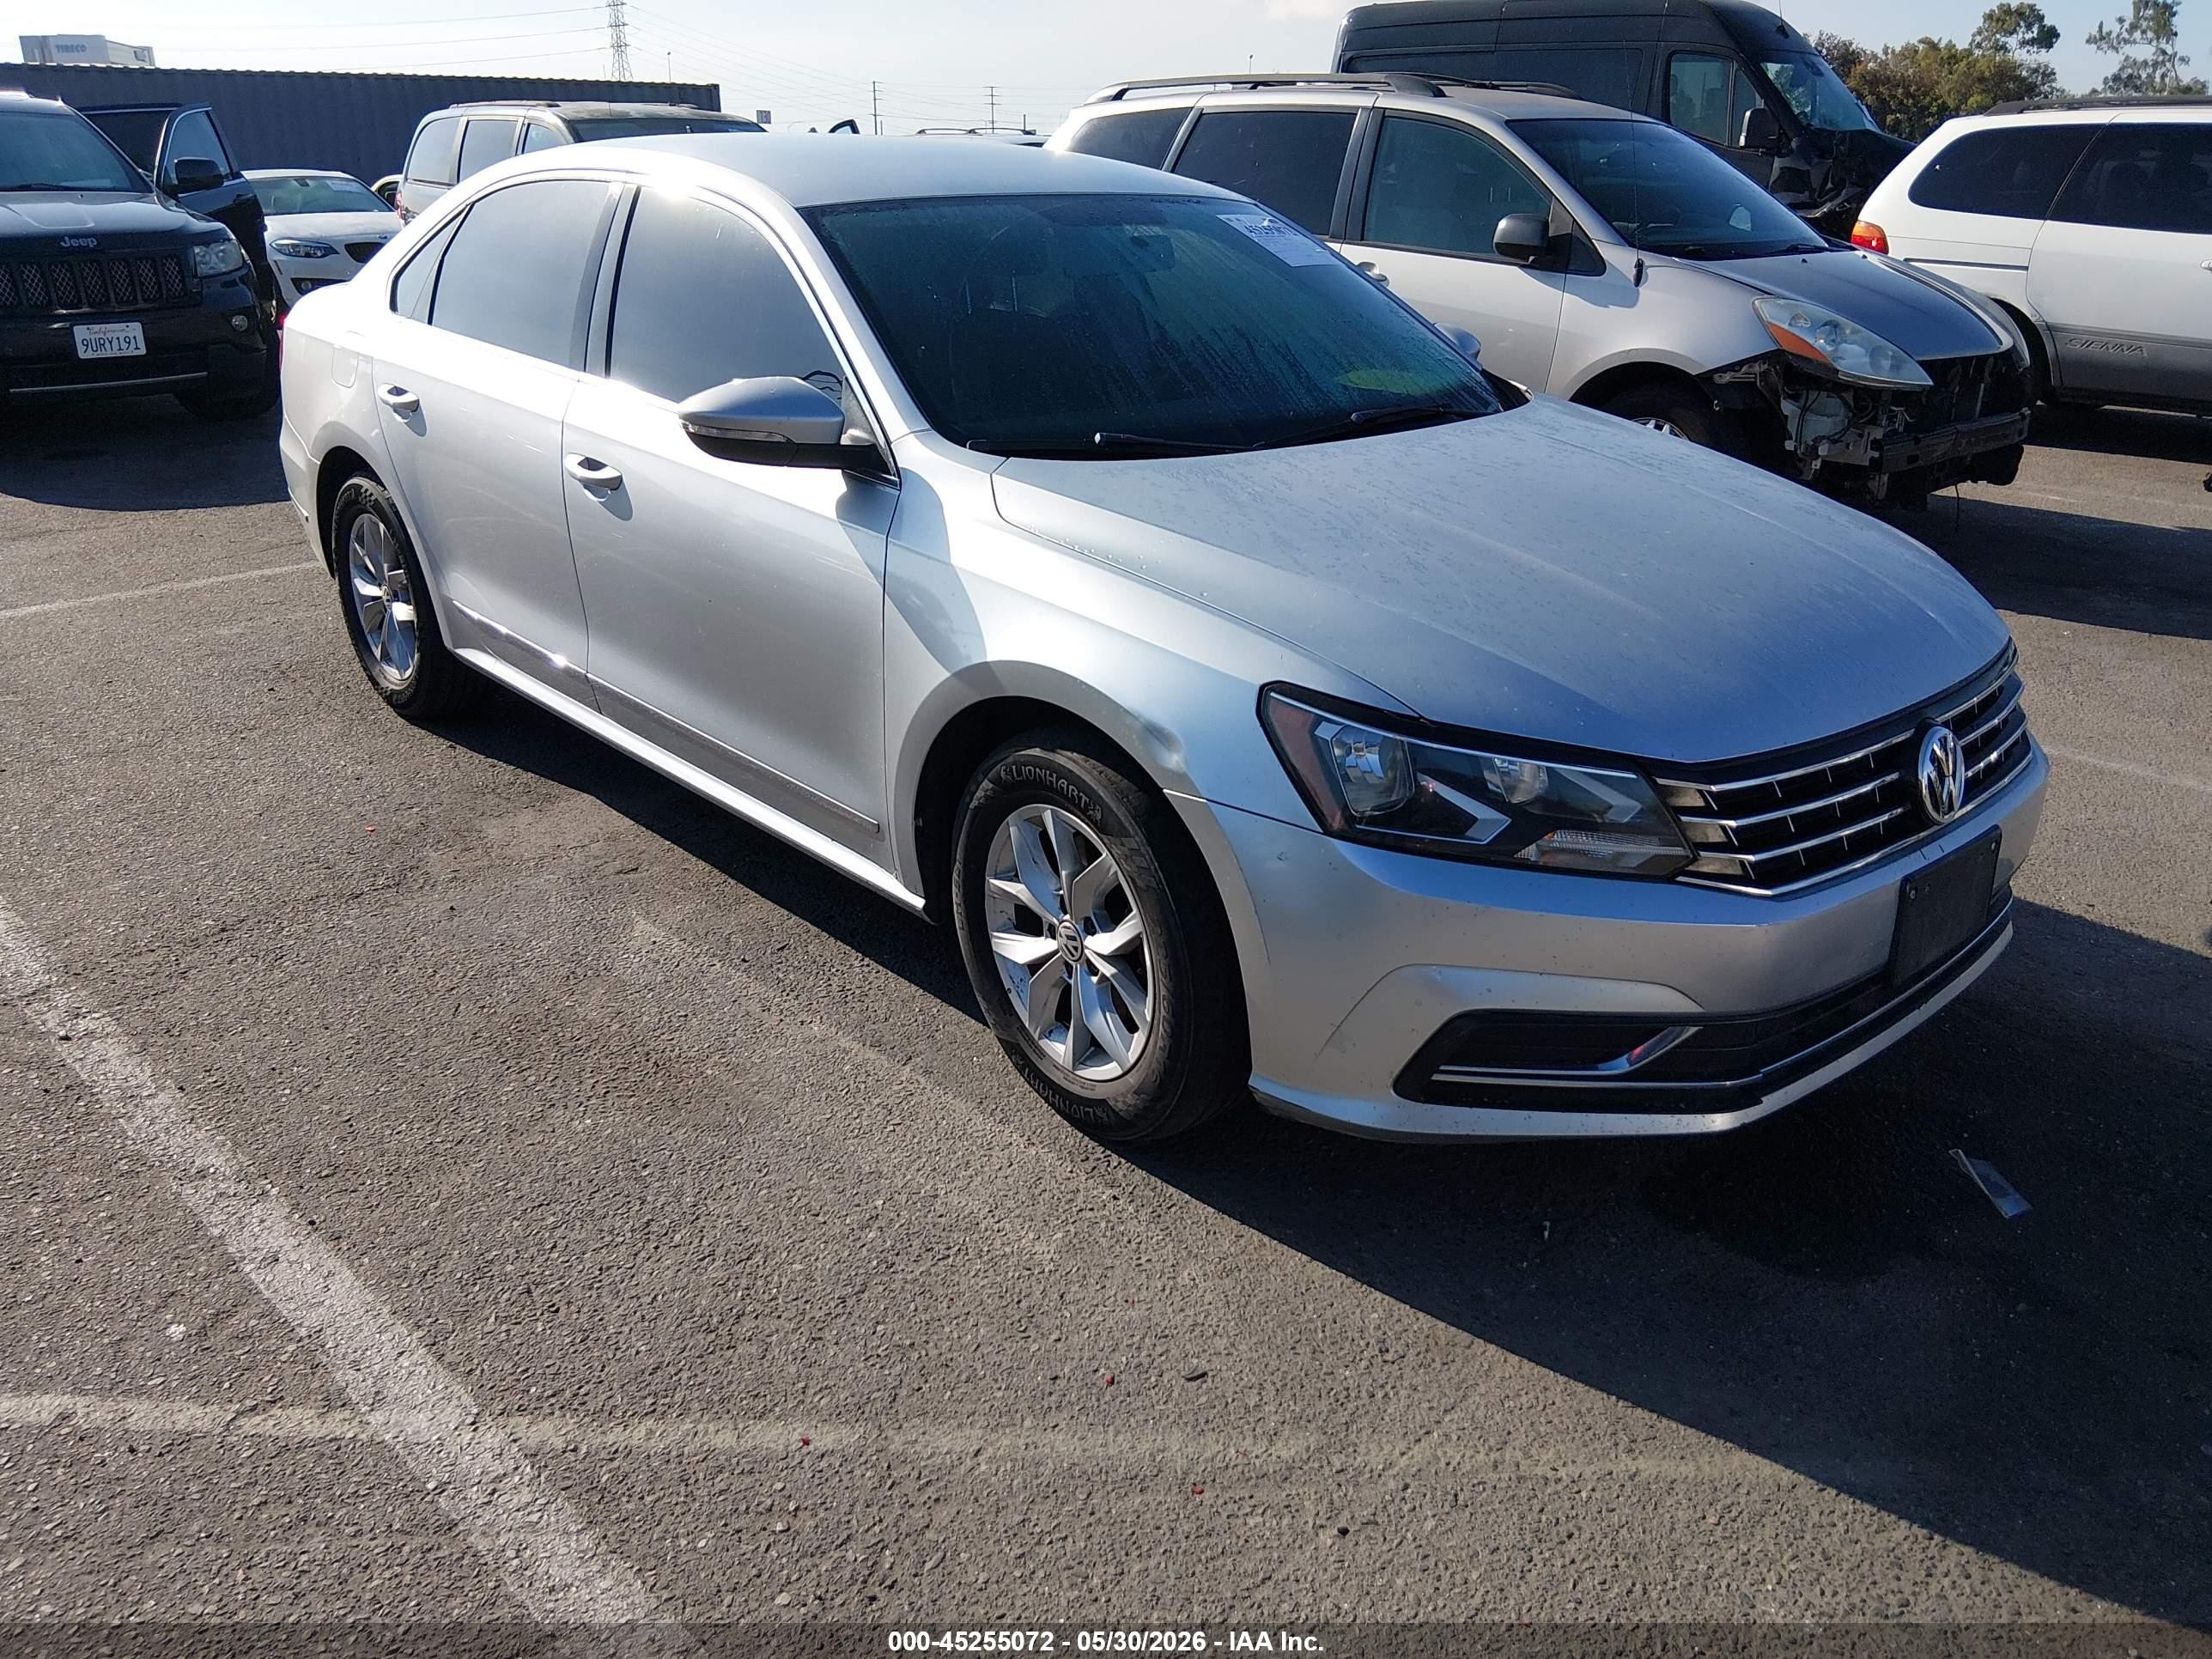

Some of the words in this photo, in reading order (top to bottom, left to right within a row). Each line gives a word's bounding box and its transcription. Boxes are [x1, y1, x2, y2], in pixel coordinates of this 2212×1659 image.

[55, 44, 87, 53] TIRECO
[60, 236, 97, 247] Jeep
[81, 335, 141, 354] 9URY191
[2065, 337, 2148, 356] SIENNA
[1012, 765, 1089, 810] LIONHART
